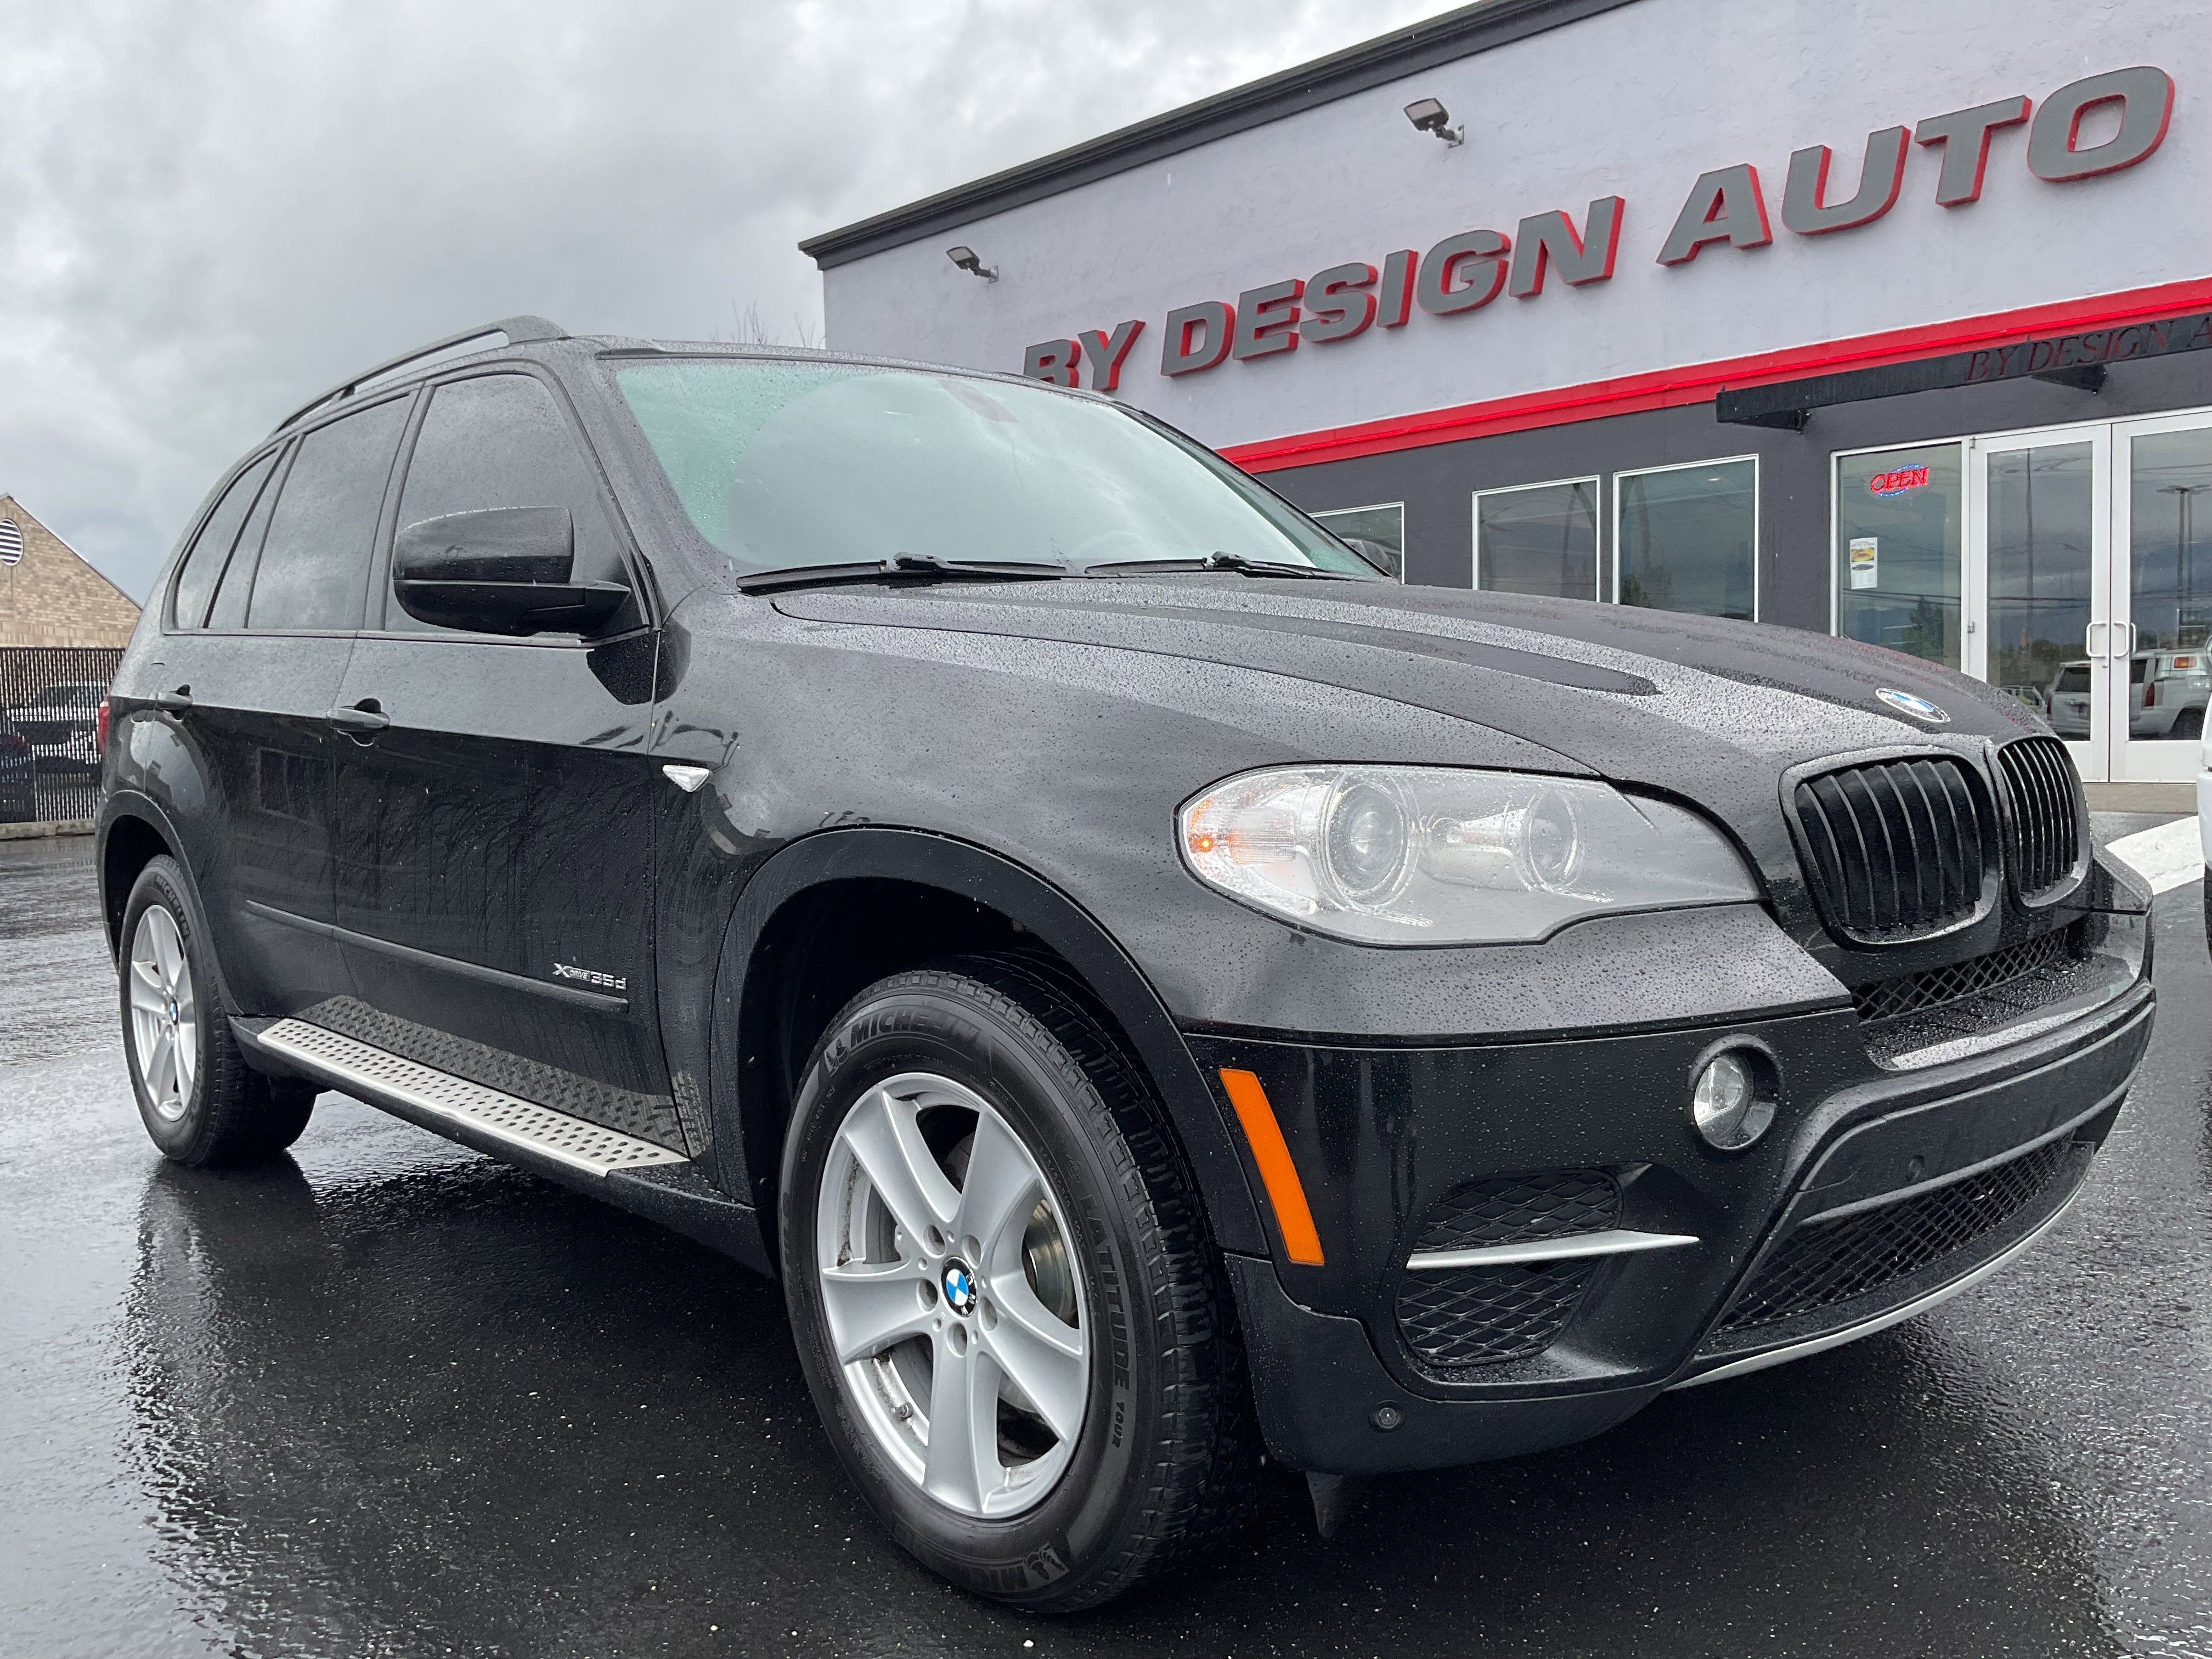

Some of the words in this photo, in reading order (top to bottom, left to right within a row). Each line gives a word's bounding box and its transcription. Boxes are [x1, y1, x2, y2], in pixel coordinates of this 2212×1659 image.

[1024, 320, 1146, 391] BY
[1160, 195, 1625, 376] DESIGN
[1656, 66, 2175, 265] AUTO
[1967, 346, 2018, 381] BY
[2027, 320, 2175, 371] DESIGN
[1871, 467, 1930, 493] OPEN
[1078, 1194, 1130, 1390] LATITUDE
